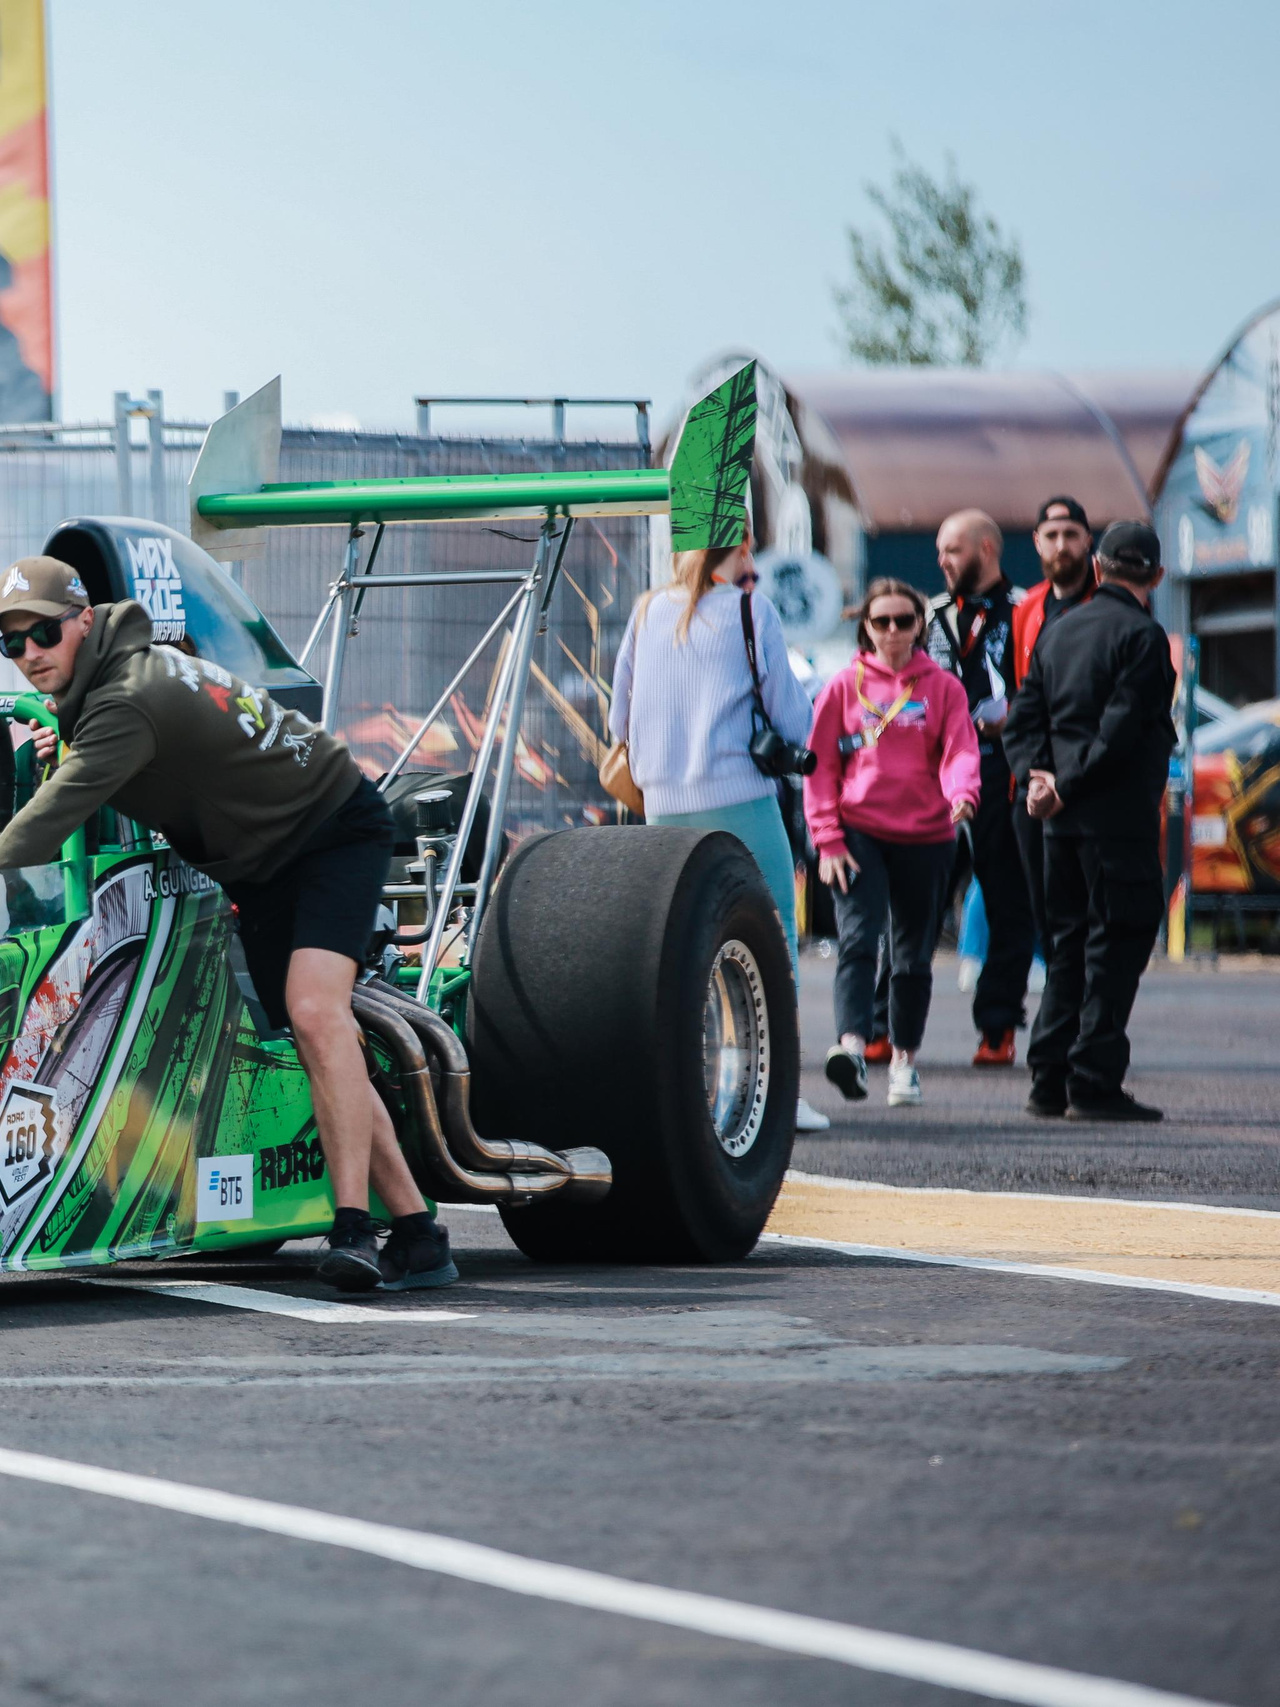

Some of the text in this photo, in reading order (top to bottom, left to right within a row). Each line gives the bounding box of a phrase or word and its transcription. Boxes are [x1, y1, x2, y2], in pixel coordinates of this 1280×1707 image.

[126, 537, 180, 578] MAX
[134, 579, 185, 620] RIDE
[152, 621, 186, 641] ORSPORT
[144, 872, 157, 899] A.
[5, 1124, 37, 1167] 160
[220, 1176, 243, 1206] ВТБ
